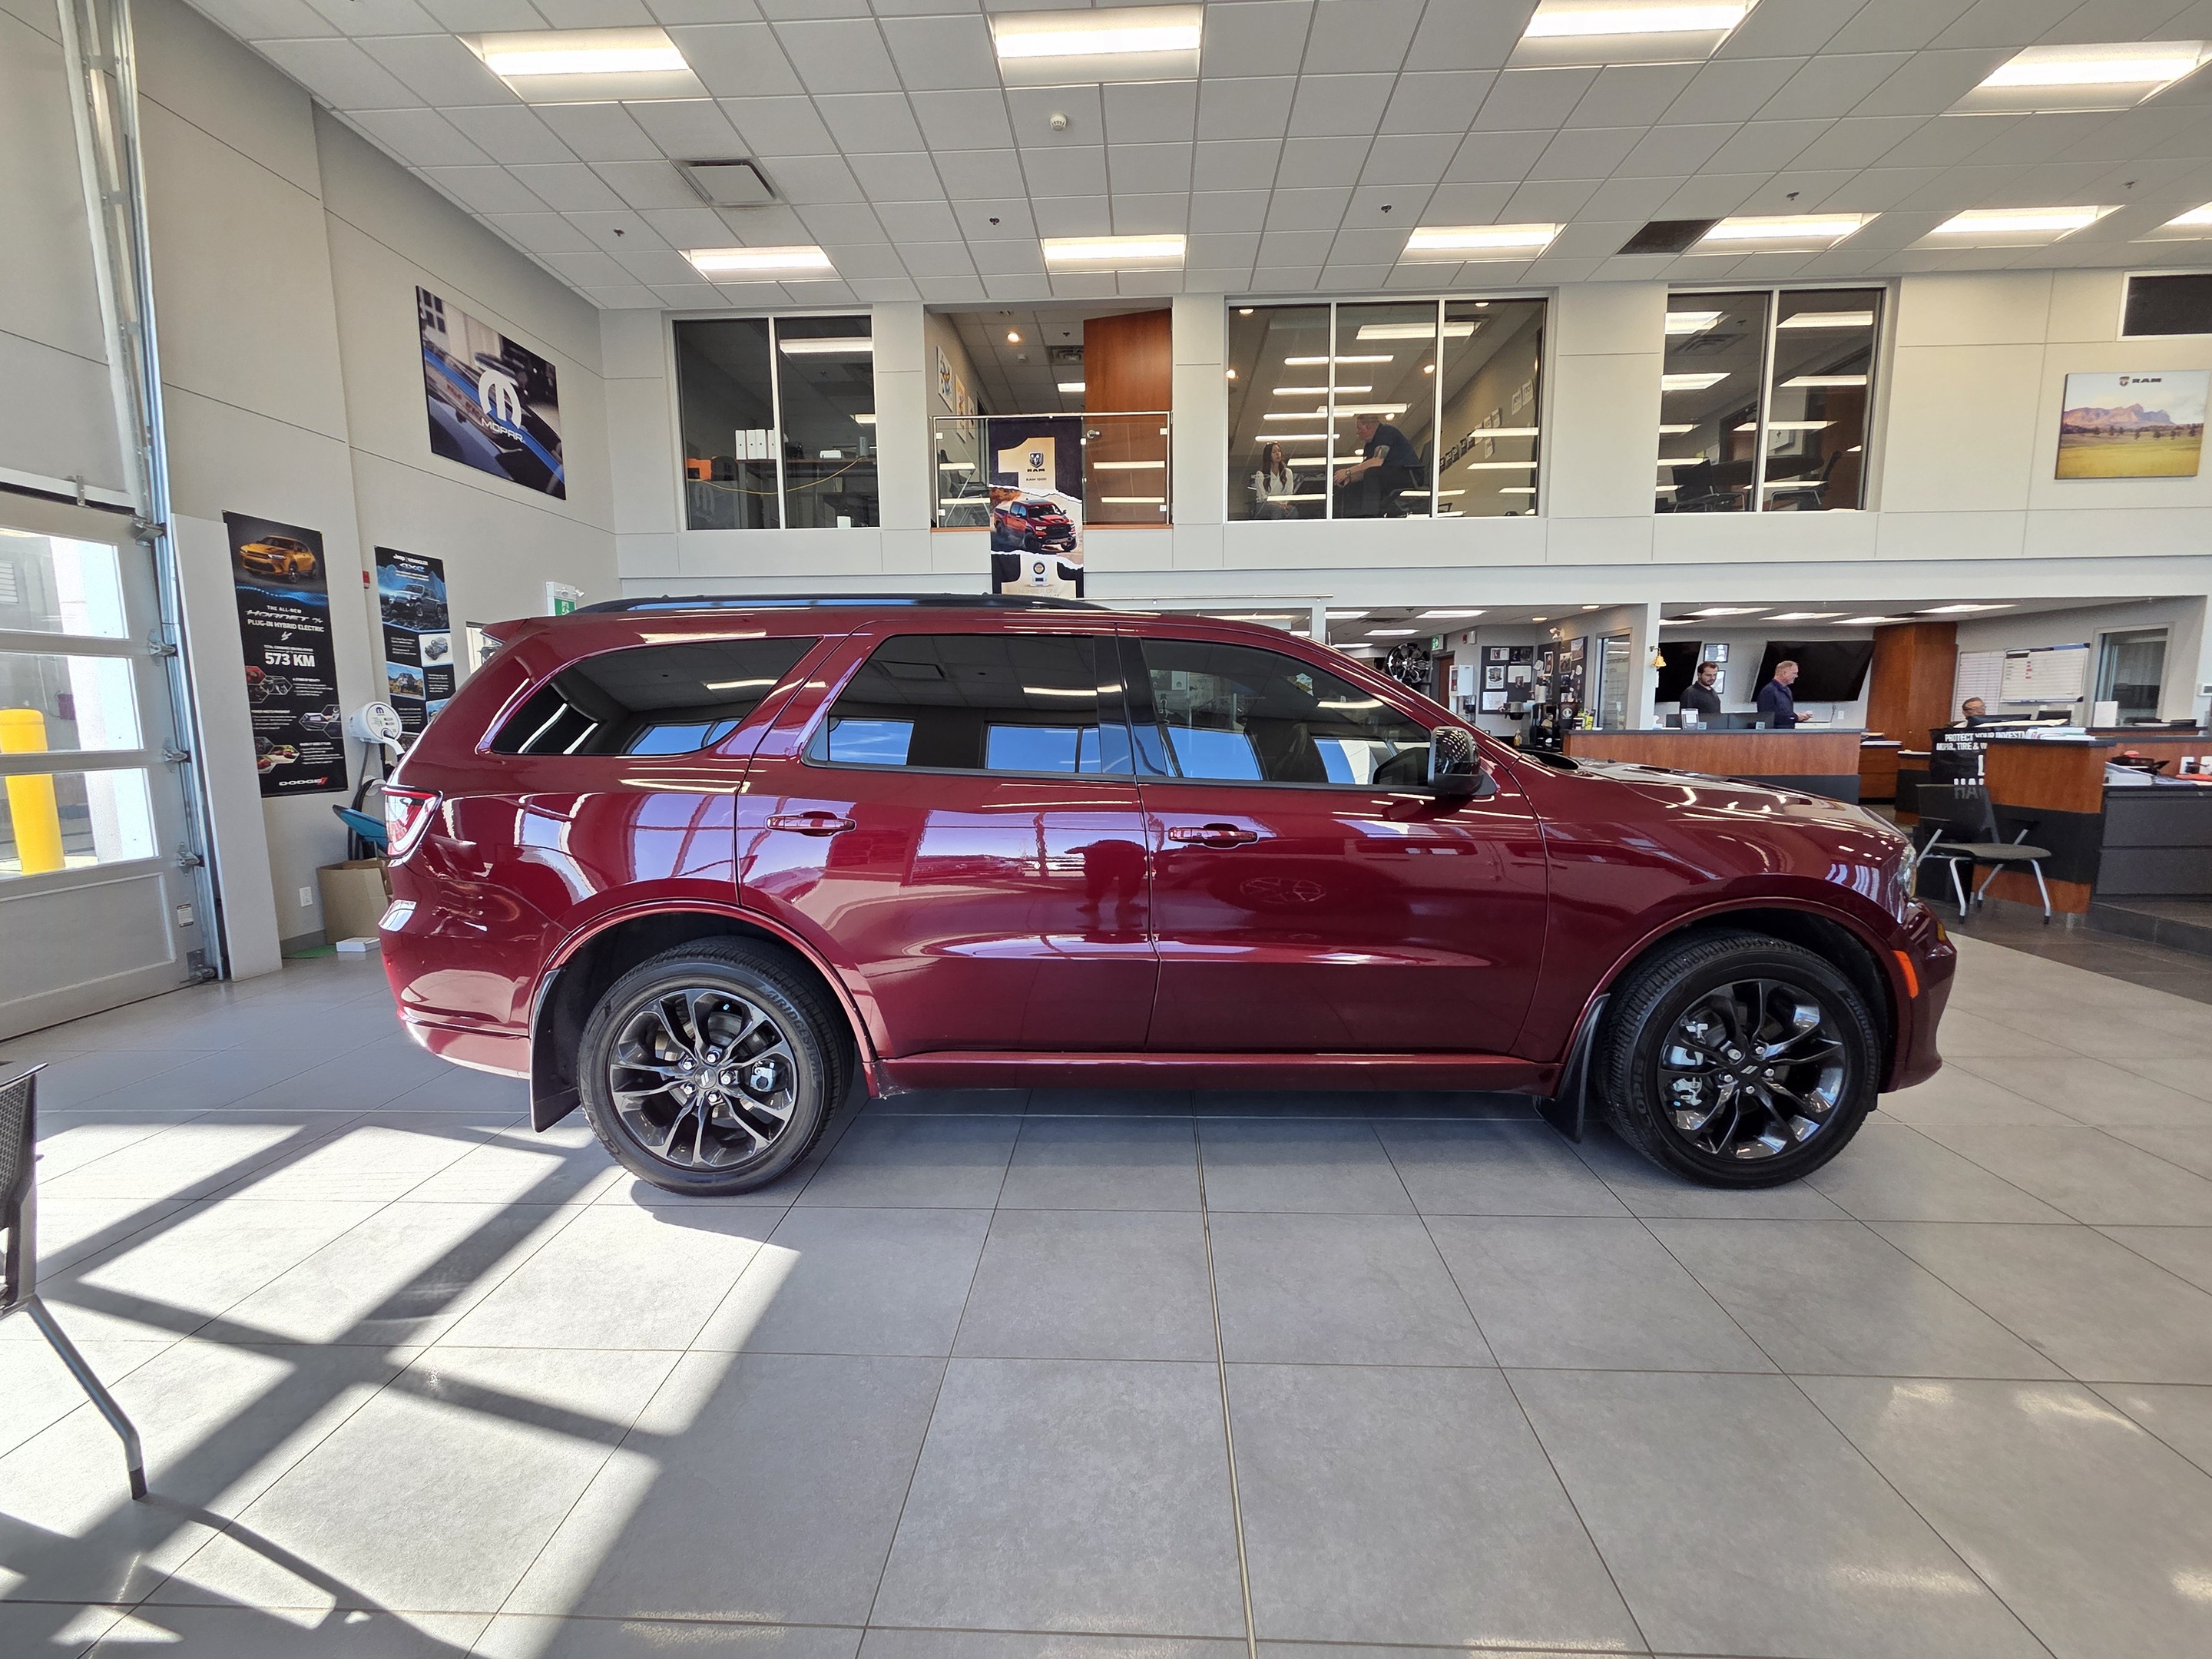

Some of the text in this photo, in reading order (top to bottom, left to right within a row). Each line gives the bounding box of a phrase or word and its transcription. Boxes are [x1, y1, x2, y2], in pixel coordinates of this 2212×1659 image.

[481, 417, 525, 443] MOPAR
[247, 618, 325, 633] PLUG-IN HYBRID ELECTRIC
[265, 651, 315, 667] 573 KM
[1945, 733, 1974, 742] PROTECT
[1956, 742, 1972, 750] TIRE
